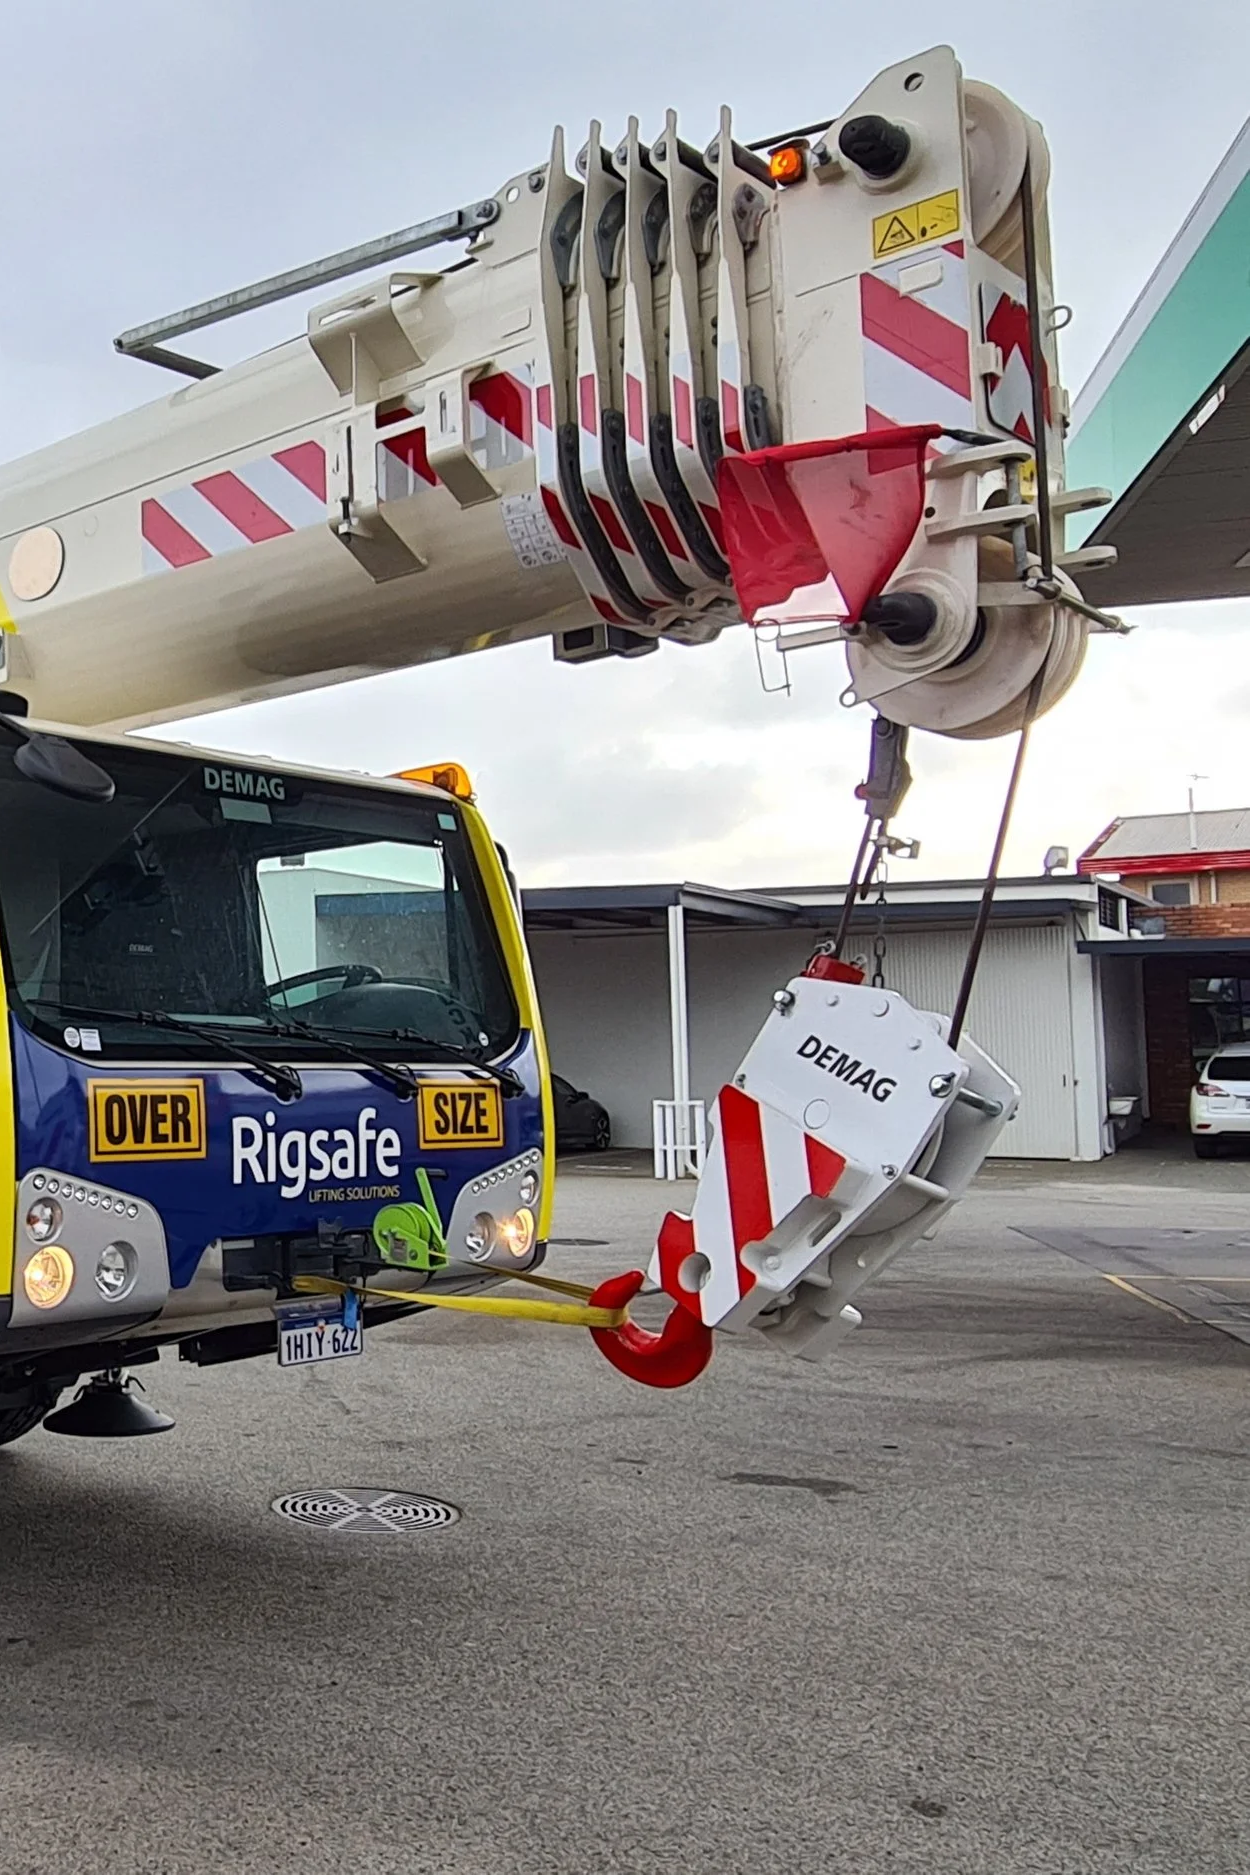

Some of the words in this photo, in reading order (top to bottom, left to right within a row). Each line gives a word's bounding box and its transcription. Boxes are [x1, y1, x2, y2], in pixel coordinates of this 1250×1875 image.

[203, 766, 286, 801] DEMAG
[795, 1034, 898, 1103] DEMAG
[104, 1093, 192, 1146] OVER
[433, 1091, 489, 1136] SIZE
[231, 1107, 401, 1199] Rigsafe
[308, 1188, 345, 1203] LIFTING
[346, 1185, 401, 1200] SOLUTIONS
